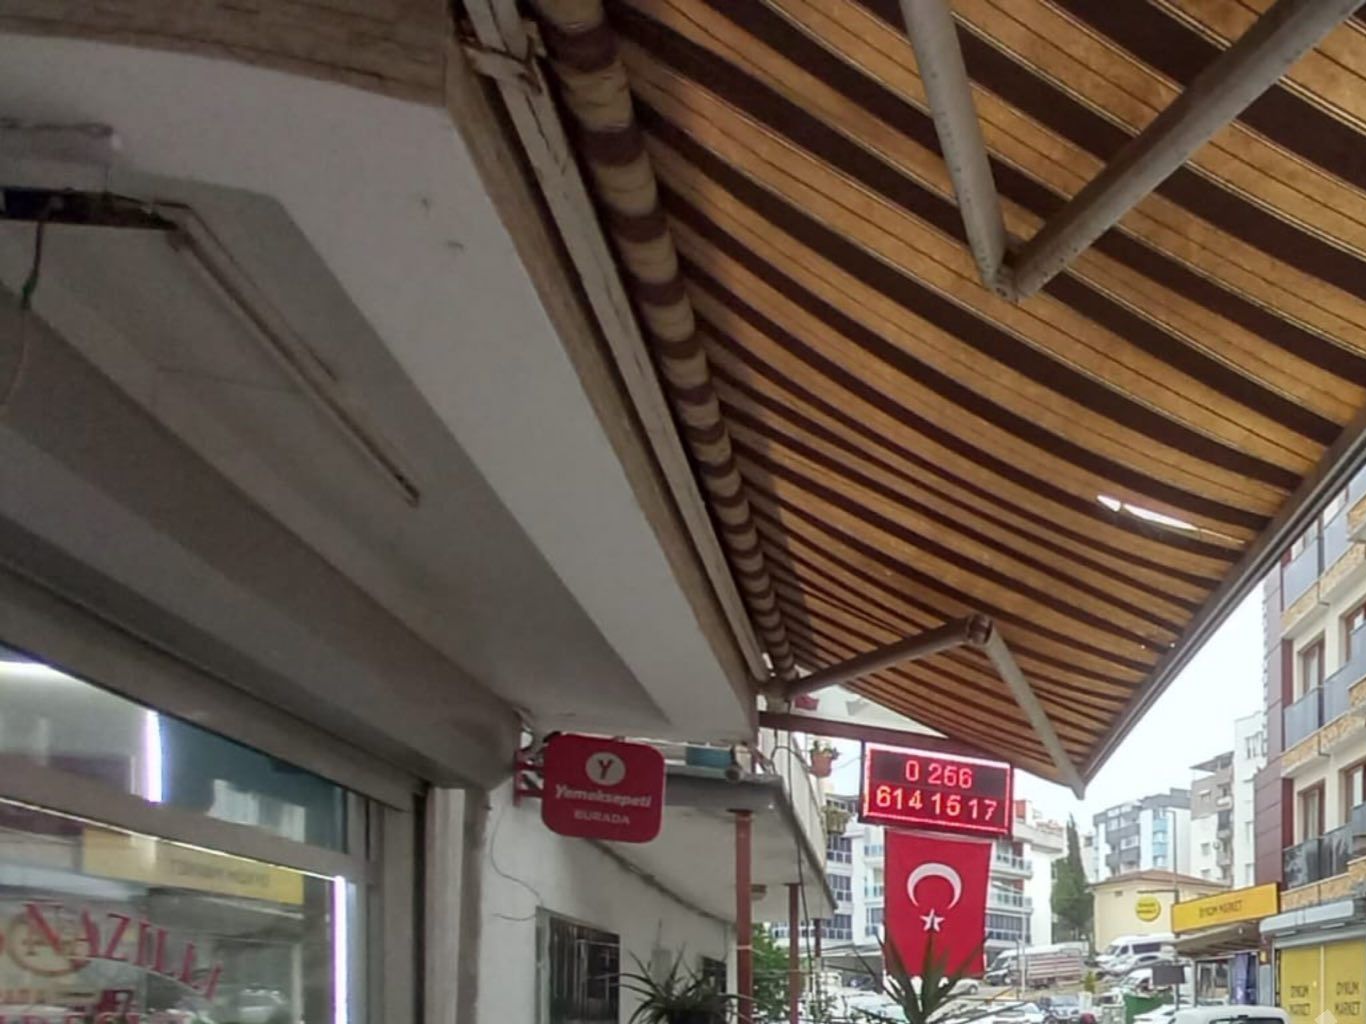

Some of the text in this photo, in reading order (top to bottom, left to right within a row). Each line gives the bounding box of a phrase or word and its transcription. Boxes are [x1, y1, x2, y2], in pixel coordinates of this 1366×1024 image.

[905, 760, 919, 781] 0
[876, 785, 923, 811] 614
[968, 798, 997, 821] 17
[574, 809, 631, 825] BURADA
